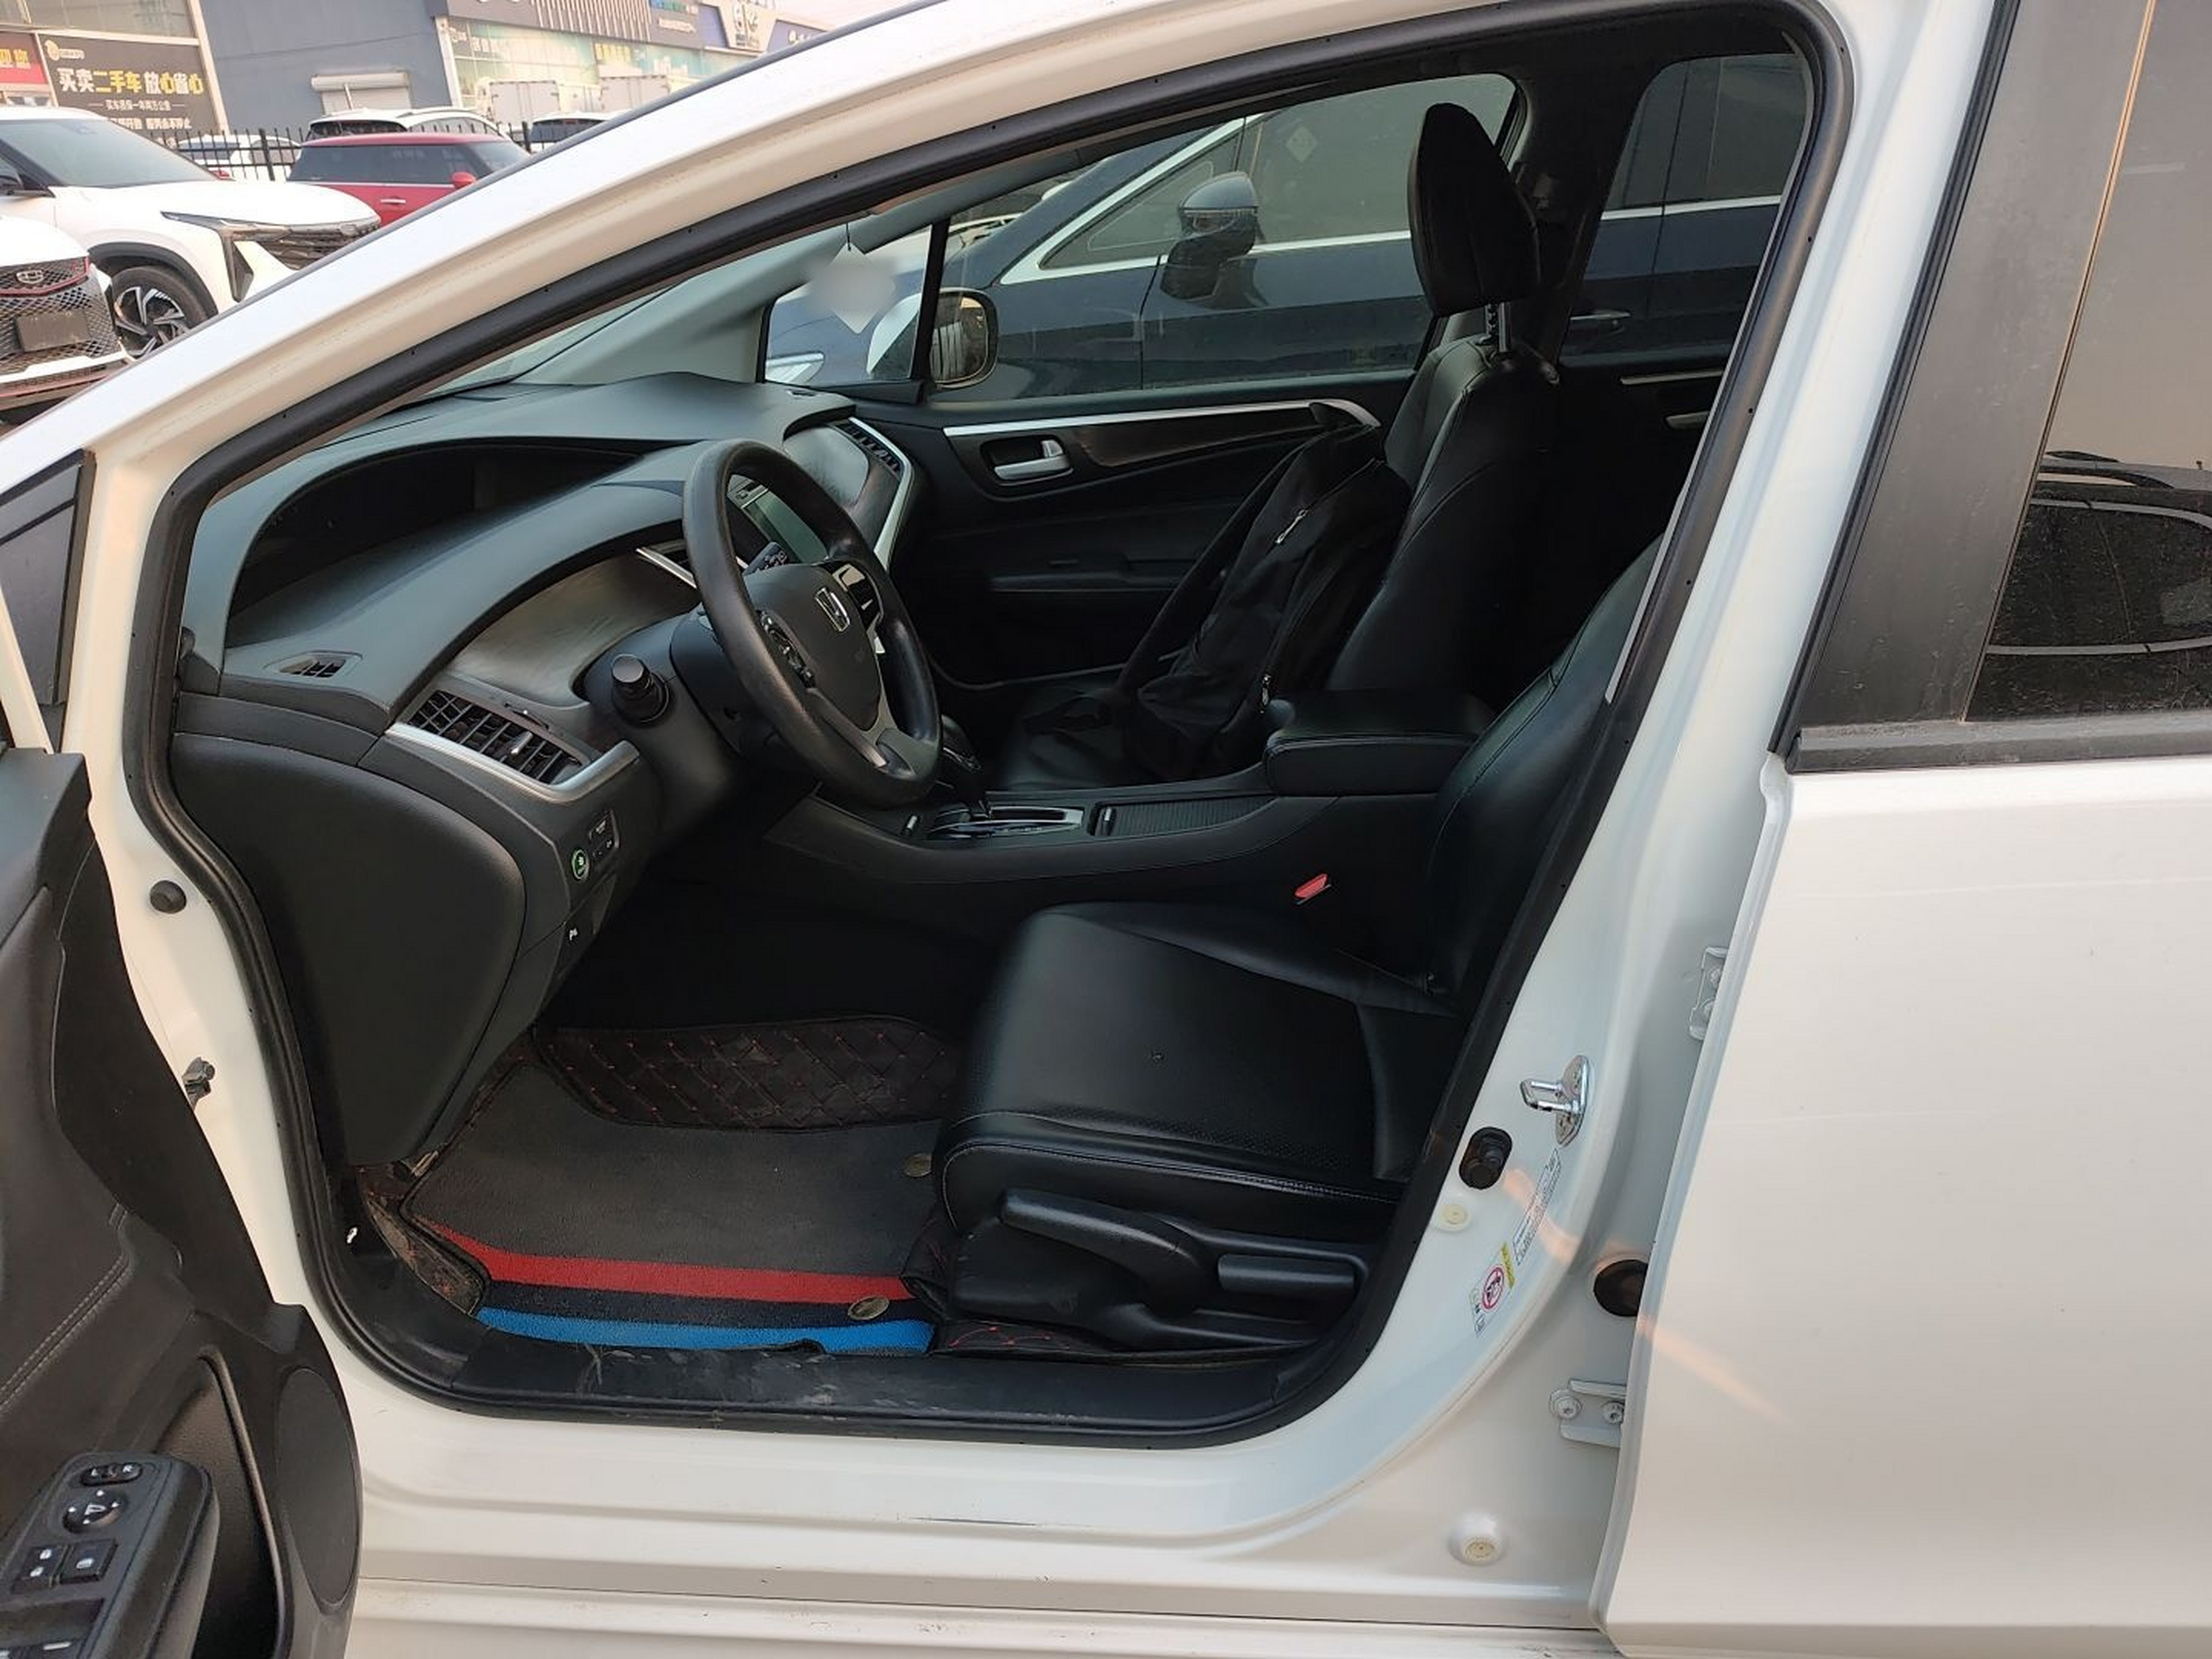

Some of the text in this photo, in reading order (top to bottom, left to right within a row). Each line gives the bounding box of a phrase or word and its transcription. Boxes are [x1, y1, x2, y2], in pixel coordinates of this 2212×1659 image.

[58, 67, 204, 94] 买卖二手车 放心省心
[122, 1464, 133, 1473] R
